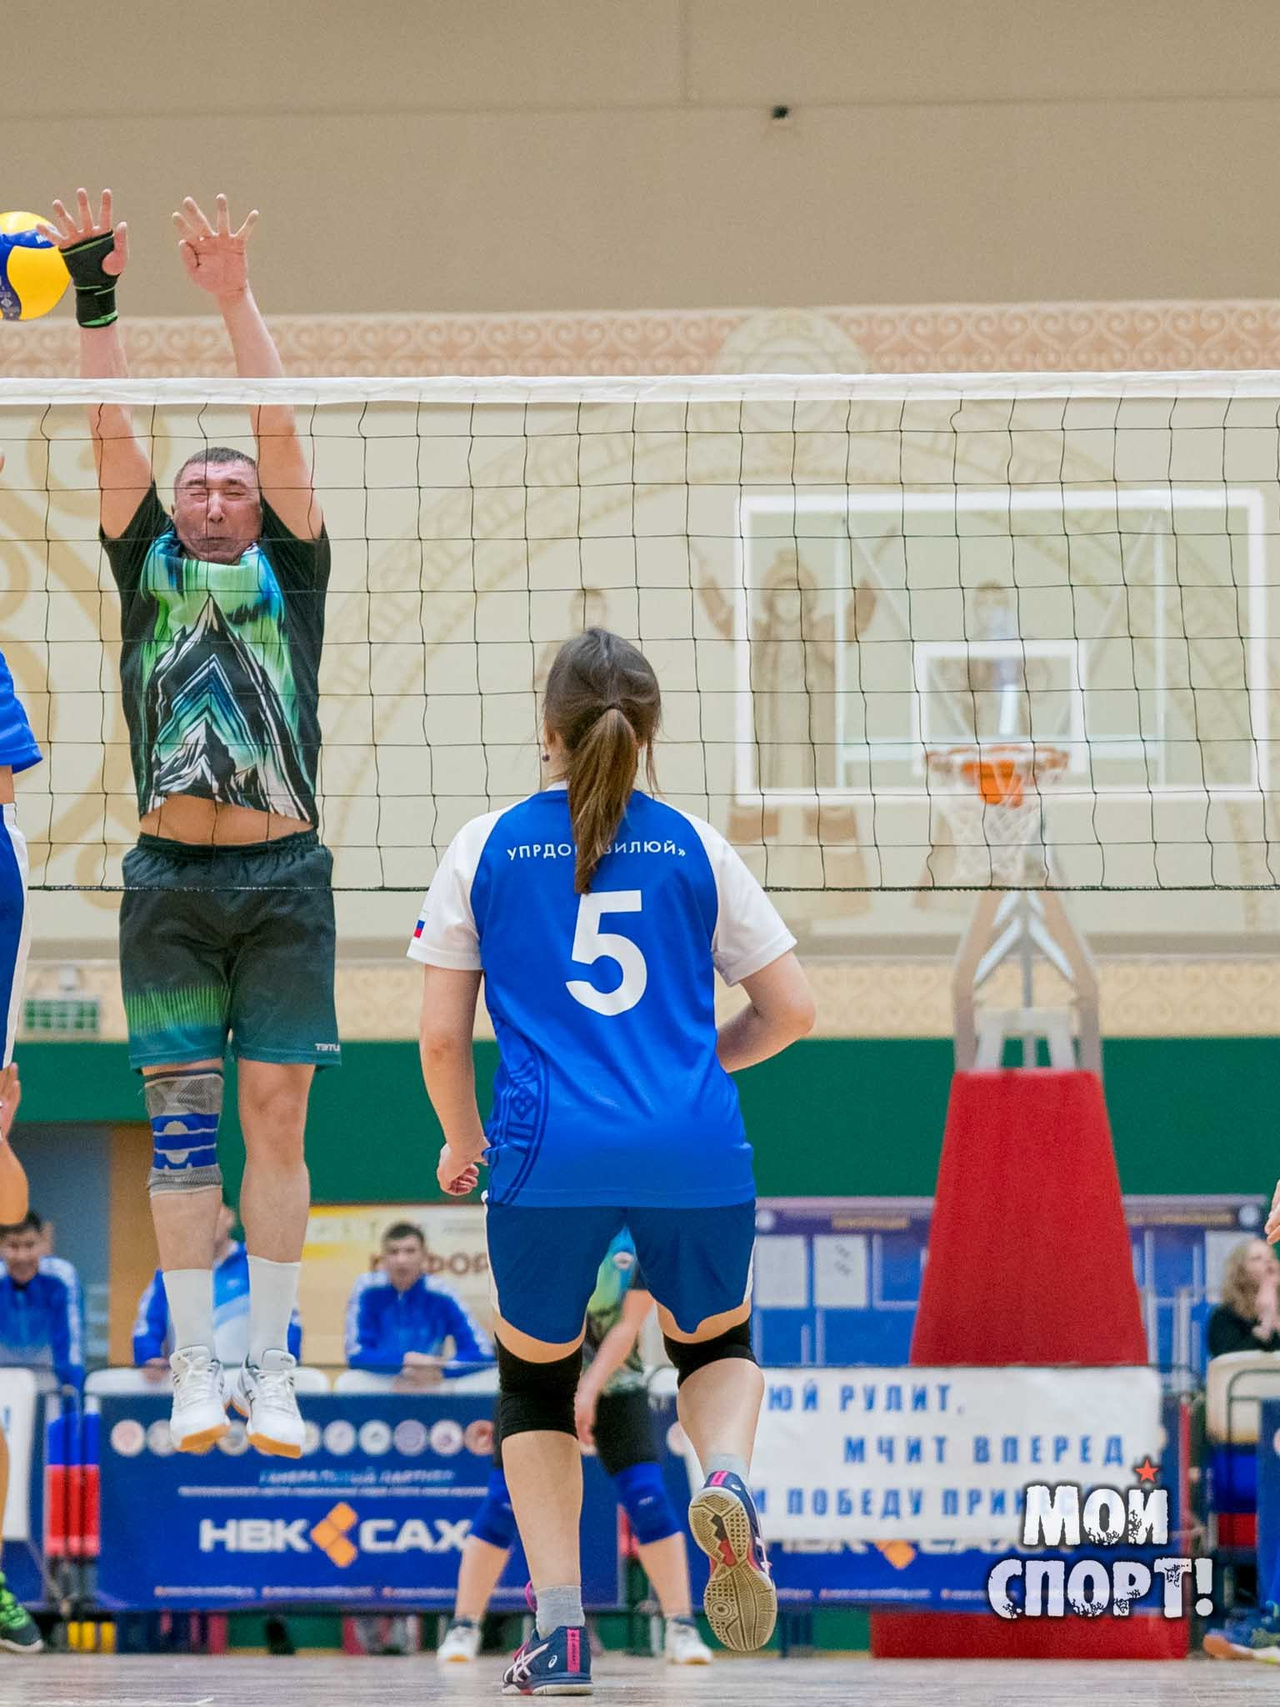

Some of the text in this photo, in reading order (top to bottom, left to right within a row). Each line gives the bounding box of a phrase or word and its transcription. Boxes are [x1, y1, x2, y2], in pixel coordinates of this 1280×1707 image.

[507, 843, 577, 861] УПРДО
[565, 890, 648, 1017] 5
[843, 1435, 1123, 1467] МЧИТ ВПЕРЕД
[787, 1487, 923, 1519] ПОБЕДУ
[359, 1519, 474, 1553] САХ
